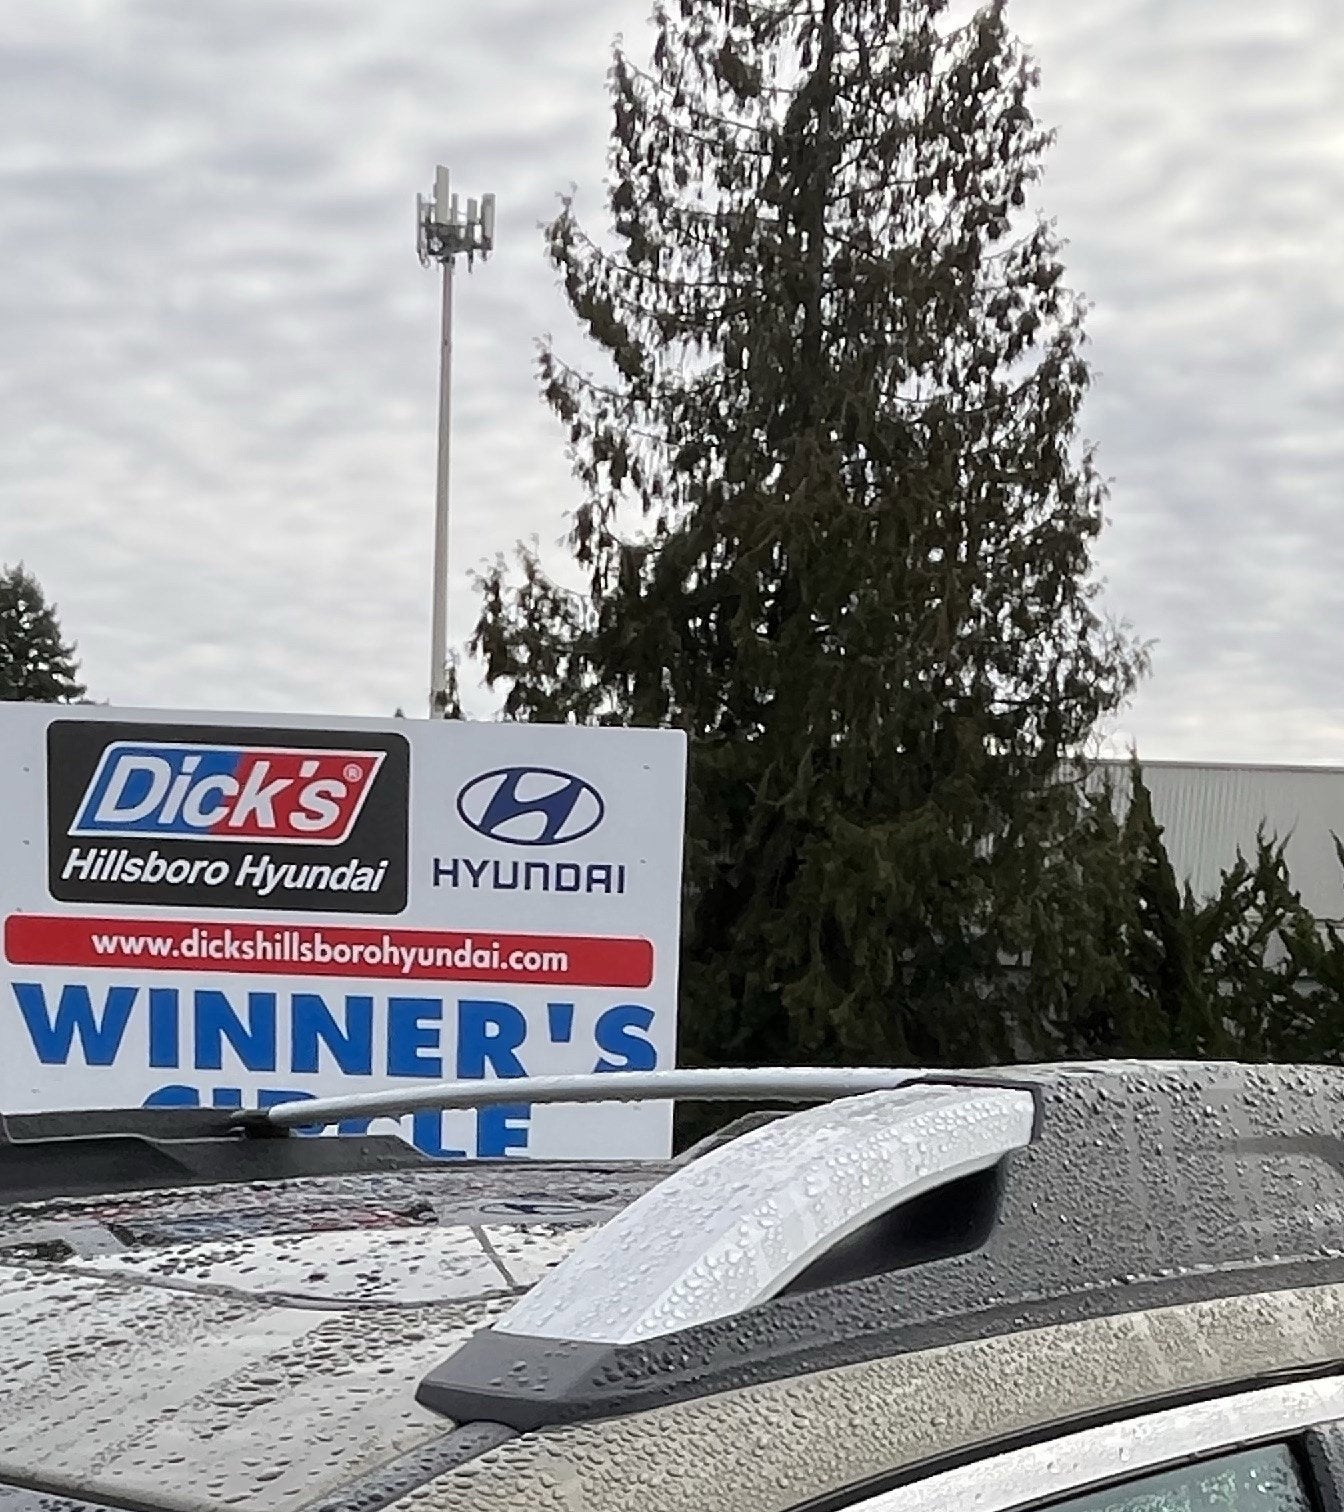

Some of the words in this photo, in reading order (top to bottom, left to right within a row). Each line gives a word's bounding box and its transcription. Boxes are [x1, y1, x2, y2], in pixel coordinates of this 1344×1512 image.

[94, 754, 348, 833] Dick's
[61, 847, 230, 886] Hillsboro
[234, 854, 389, 897] Hyundai
[432, 857, 627, 895] HYUNDAI
[91, 927, 568, 975] www.dickshillsborohyundai.com
[10, 982, 658, 1079] WINNER'S
